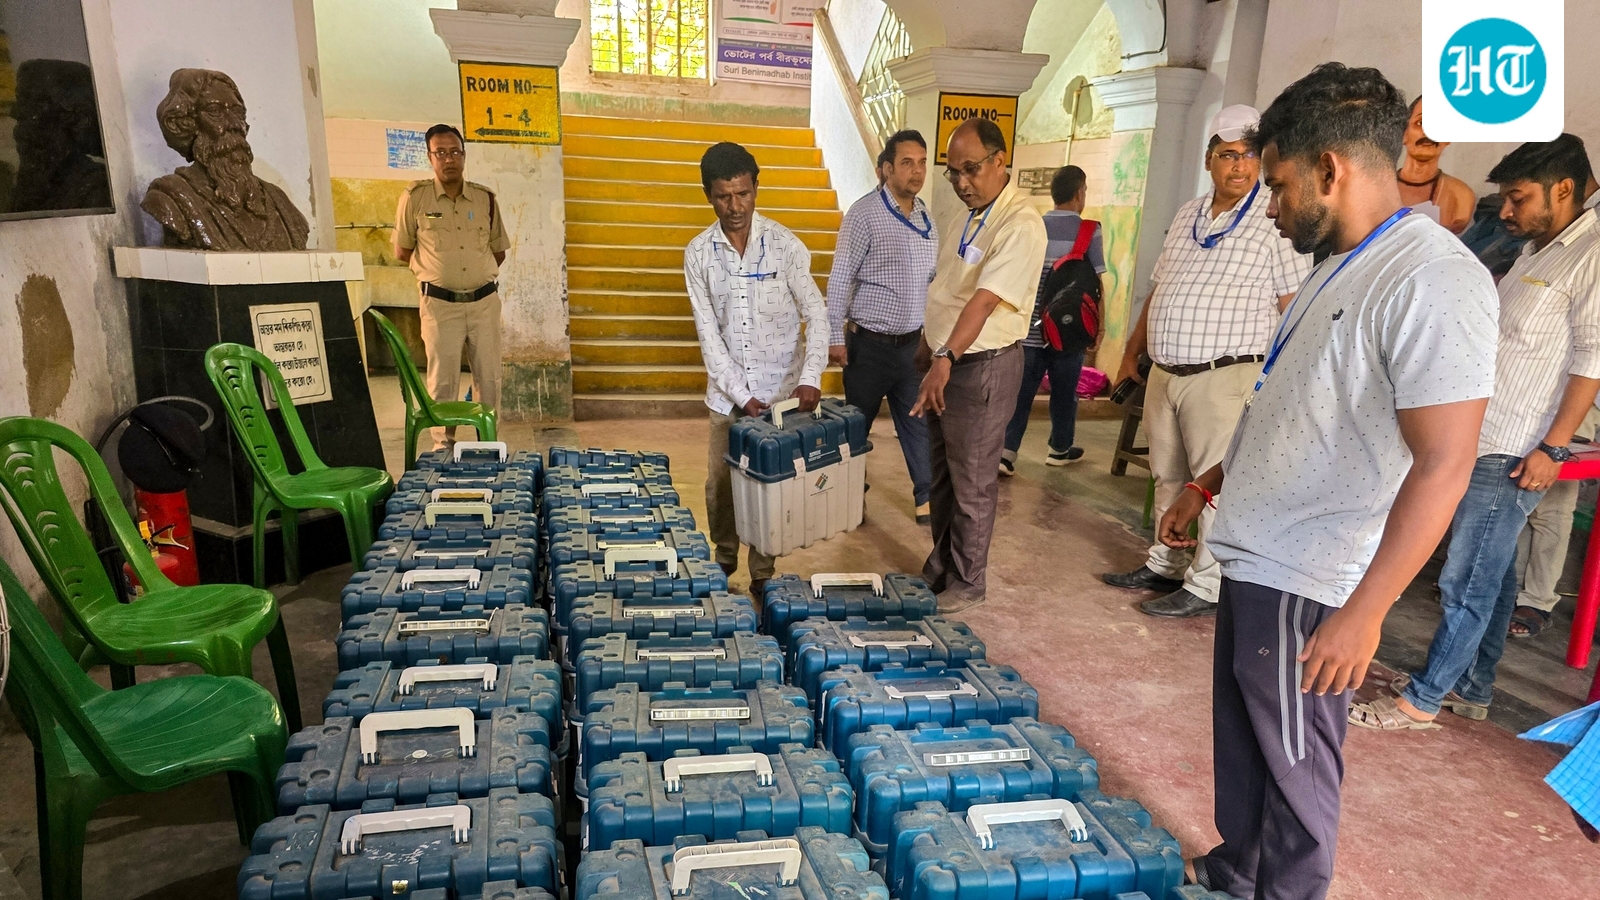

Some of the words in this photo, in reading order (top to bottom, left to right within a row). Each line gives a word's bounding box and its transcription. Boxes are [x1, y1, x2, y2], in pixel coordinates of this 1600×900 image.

[724, 49, 756, 60] ভোটের
[758, 50, 774, 62] পর্ব
[723, 66, 740, 74] Suri
[742, 66, 791, 79] Benimadhab
[466, 76, 510, 94] ROOM
[486, 106, 494, 126] 1
[518, 108, 532, 127] 4
[943, 106, 979, 121] ROOM
